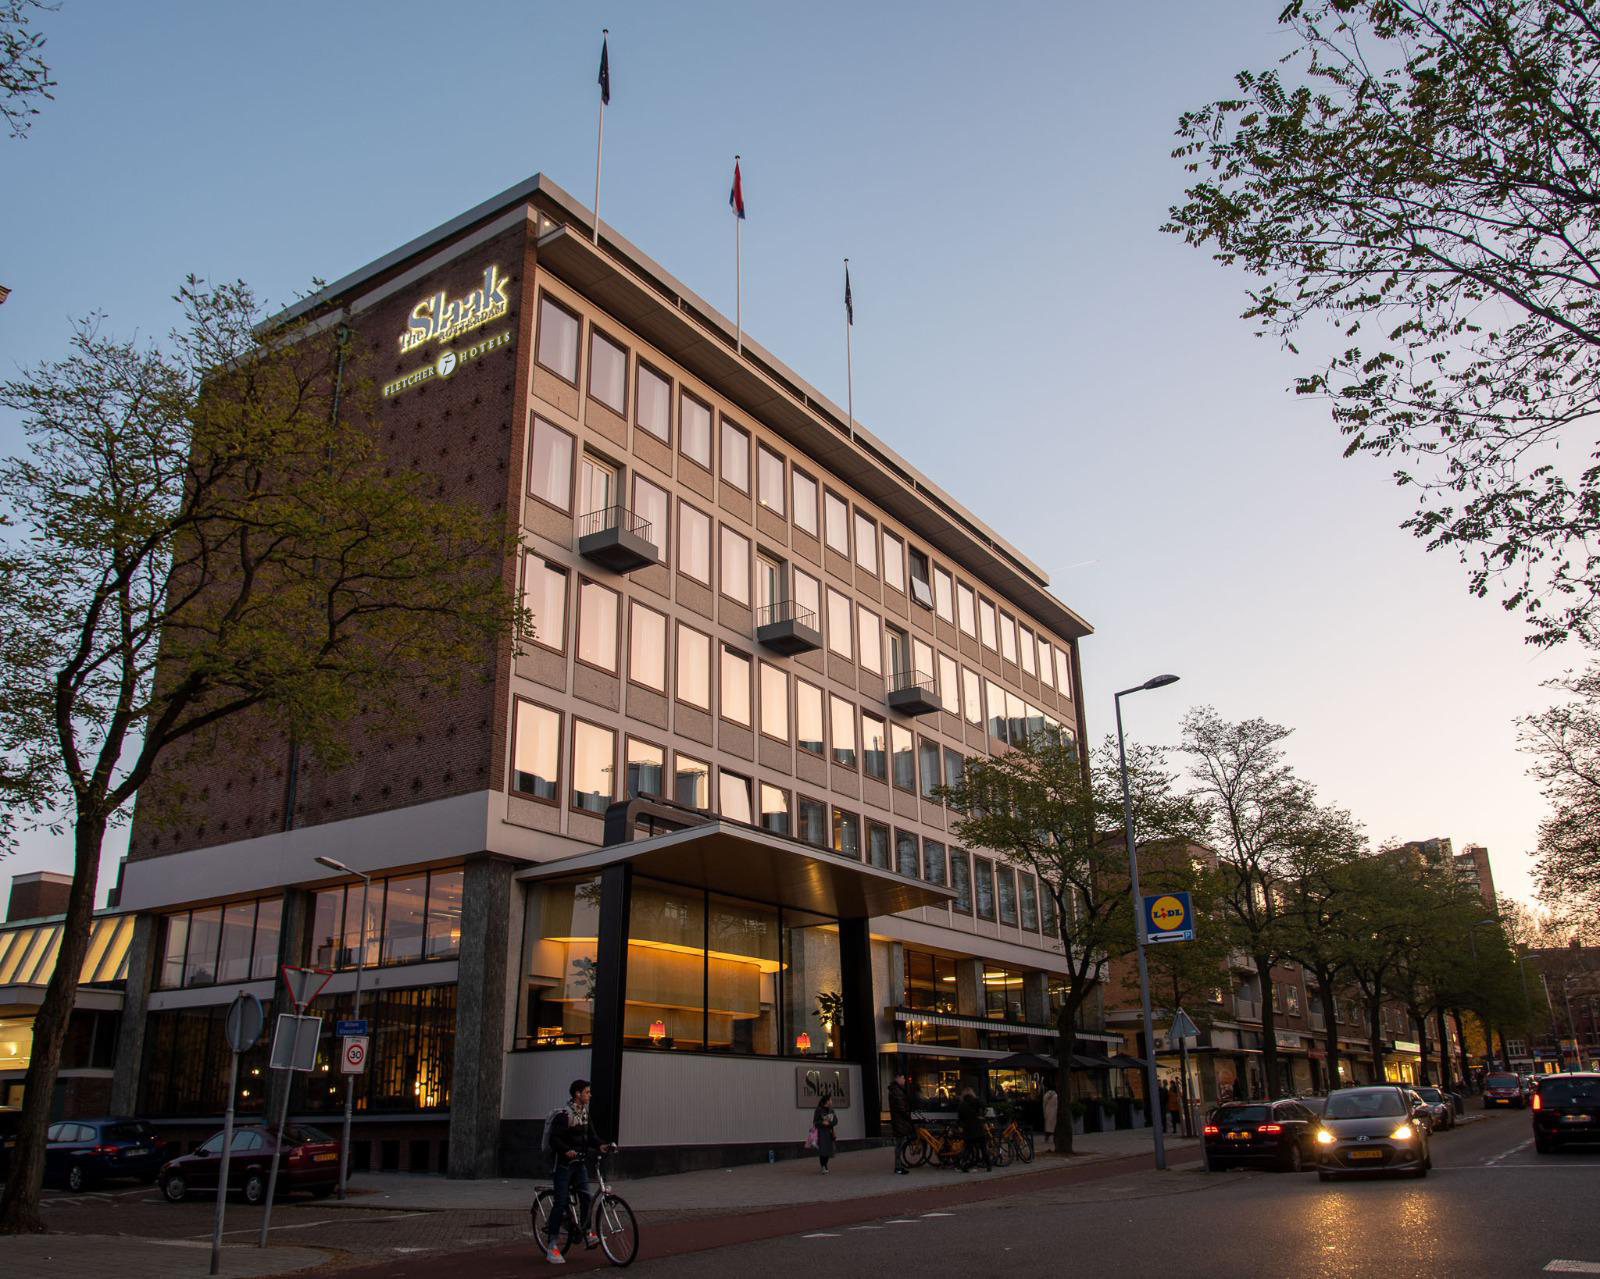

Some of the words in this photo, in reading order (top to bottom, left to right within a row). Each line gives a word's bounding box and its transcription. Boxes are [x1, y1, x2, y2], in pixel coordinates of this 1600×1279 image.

[407, 264, 509, 339] Slaak
[440, 302, 506, 342] ROTTERDAM
[384, 366, 435, 396] FLETCHER
[459, 332, 510, 362] HOTELS
[351, 1050, 361, 1059] 30
[805, 1070, 845, 1097] Slaak
